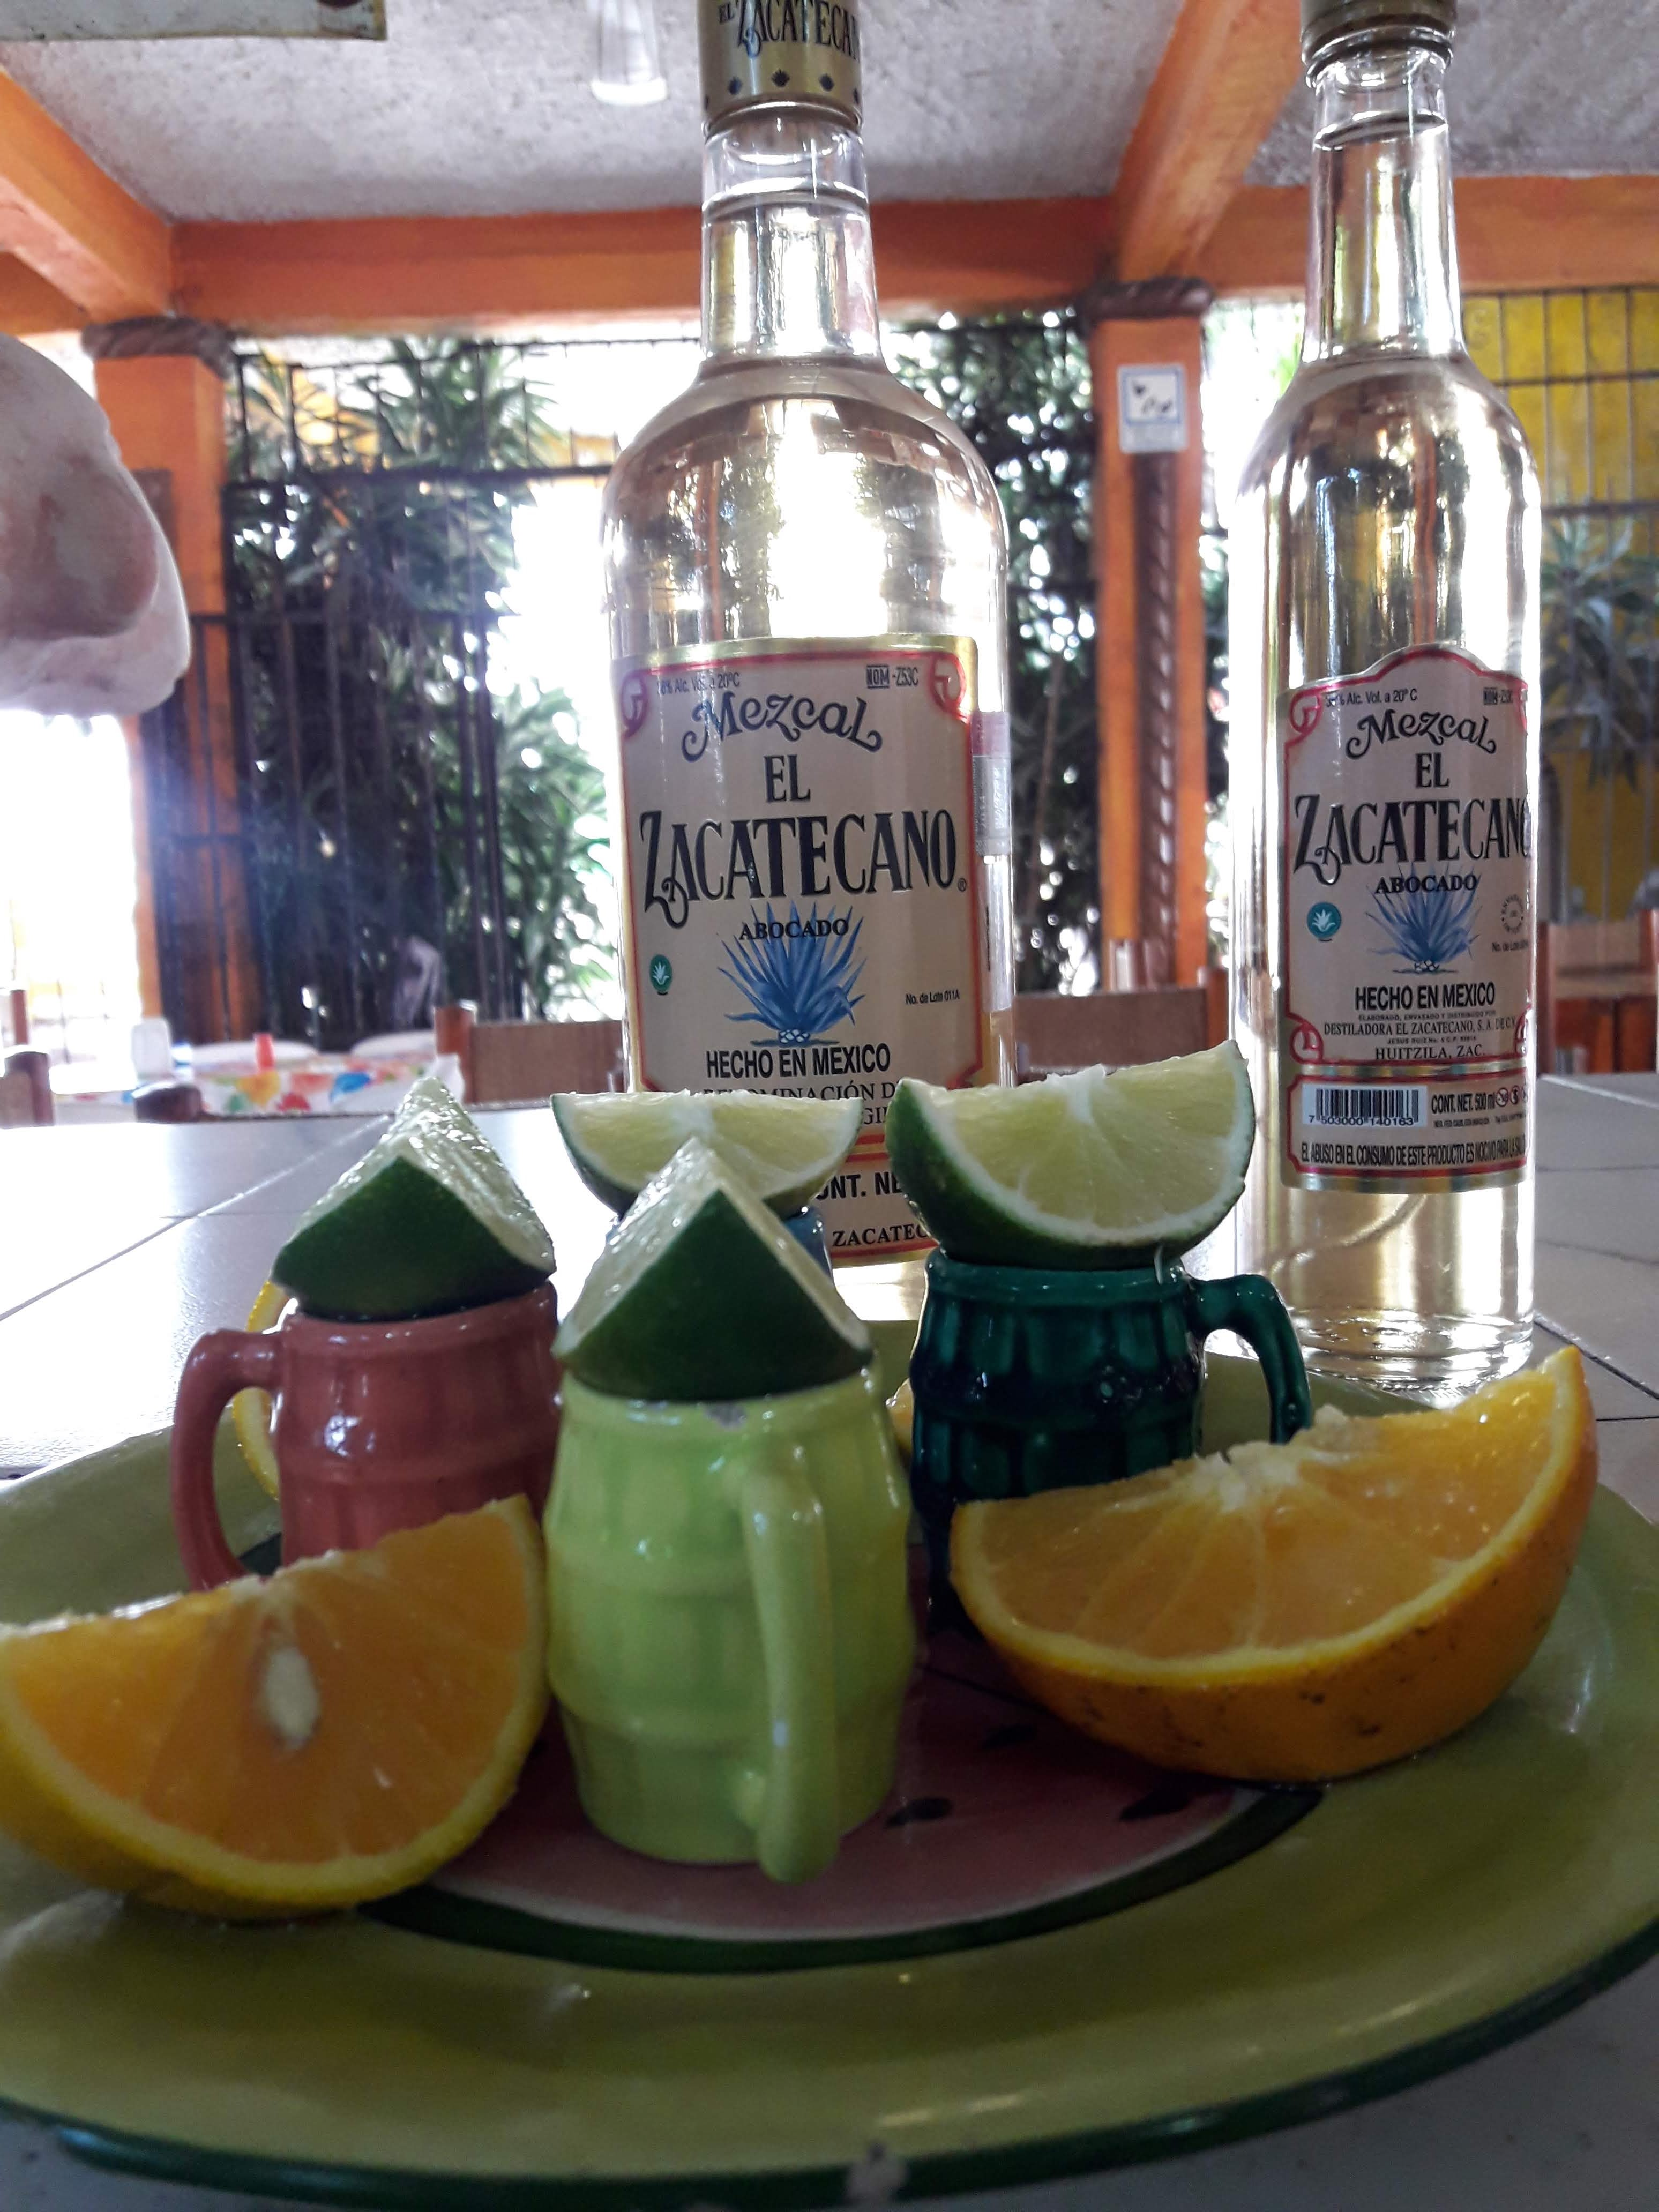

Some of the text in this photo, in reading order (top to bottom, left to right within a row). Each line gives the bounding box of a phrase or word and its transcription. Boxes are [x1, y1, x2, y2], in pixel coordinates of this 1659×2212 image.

[866, 666, 890, 687] NOM
[1365, 690, 1382, 704] Vol.
[1384, 692, 1391, 703] a
[681, 691, 883, 761] Mezcal
[1346, 709, 1497, 760] Mezcal
[764, 754, 811, 803] EL
[1416, 752, 1450, 788] EL
[639, 809, 956, 930] ZACATECANO
[1375, 873, 1478, 894] ABOCADO
[739, 917, 849, 940] ABOCADO
[1355, 981, 1496, 1011] HECHO EN MEXICO
[1324, 1022, 1393, 1036] DESTILADORA
[1395, 1022, 1409, 1035] EL
[1410, 1019, 1475, 1035] ZACATECANO,
[706, 1043, 891, 1079] HECHO EN MEXICO
[1376, 1046, 1452, 1059] HUITZILA,
[1431, 1094, 1456, 1115] CONT.
[1457, 1093, 1474, 1112] NET.
[1308, 1115, 1316, 1124] 7
[1321, 1116, 1364, 1126] 503000
[1302, 1142, 1309, 1162] EL
[1311, 1142, 1334, 1164] ABUSO
[1335, 1144, 1346, 1164] EN
[1346, 1145, 1356, 1165] EL
[1357, 1144, 1395, 1166] CONSUMO
[1395, 1145, 1408, 1166] DE
[1408, 1145, 1426, 1166] ESTE
[1426, 1142, 1465, 1166] PRODUCTO
[1466, 1142, 1474, 1164] ES
